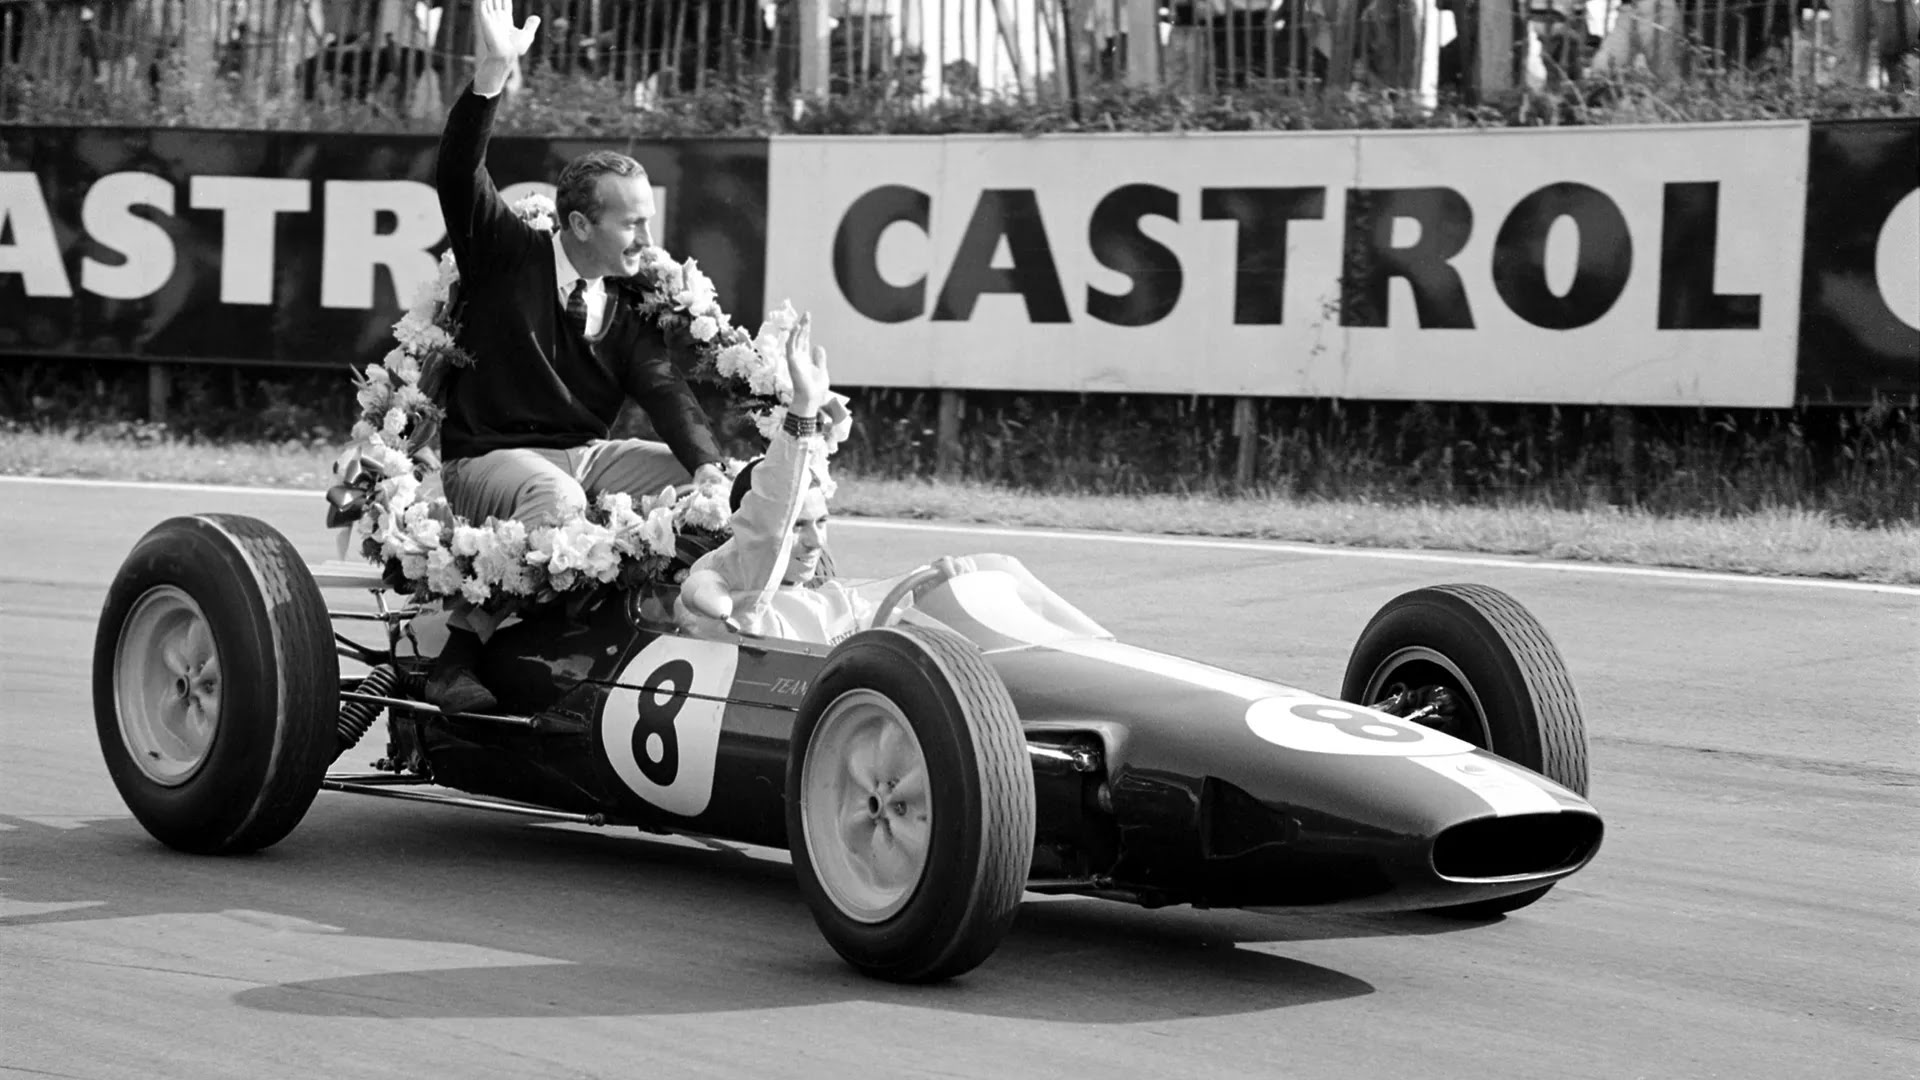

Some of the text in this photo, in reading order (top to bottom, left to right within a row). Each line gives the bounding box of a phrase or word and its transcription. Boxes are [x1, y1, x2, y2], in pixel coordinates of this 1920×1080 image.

[833, 182, 1762, 331] CASTROL
[632, 659, 694, 786] 8
[1290, 704, 1425, 742] 8
